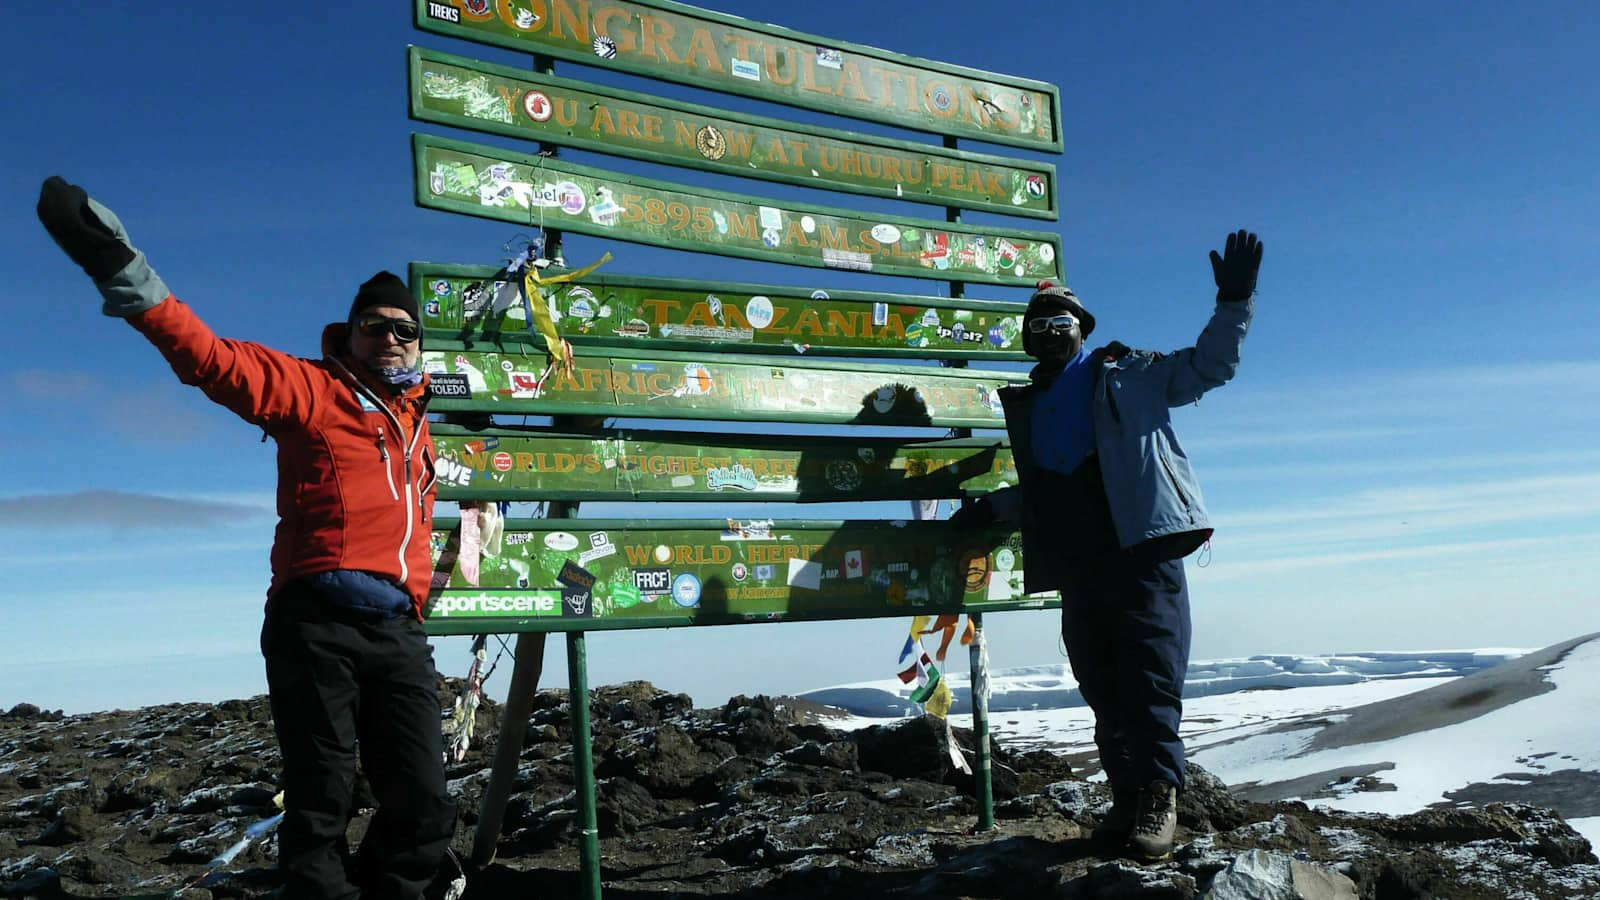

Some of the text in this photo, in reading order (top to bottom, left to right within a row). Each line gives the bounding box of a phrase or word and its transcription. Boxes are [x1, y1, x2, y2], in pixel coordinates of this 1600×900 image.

[429, 2, 460, 22] TREKS
[496, 84, 1007, 197] YU ARE NW AT UHURU PEAK
[621, 193, 715, 234] 5895
[642, 298, 908, 340] TANZANIA
[429, 383, 468, 395] TOLEDO
[434, 457, 473, 487] OVE
[461, 450, 603, 474] WRLD'S
[624, 544, 732, 566] WORLD
[430, 593, 554, 616] sportscene
